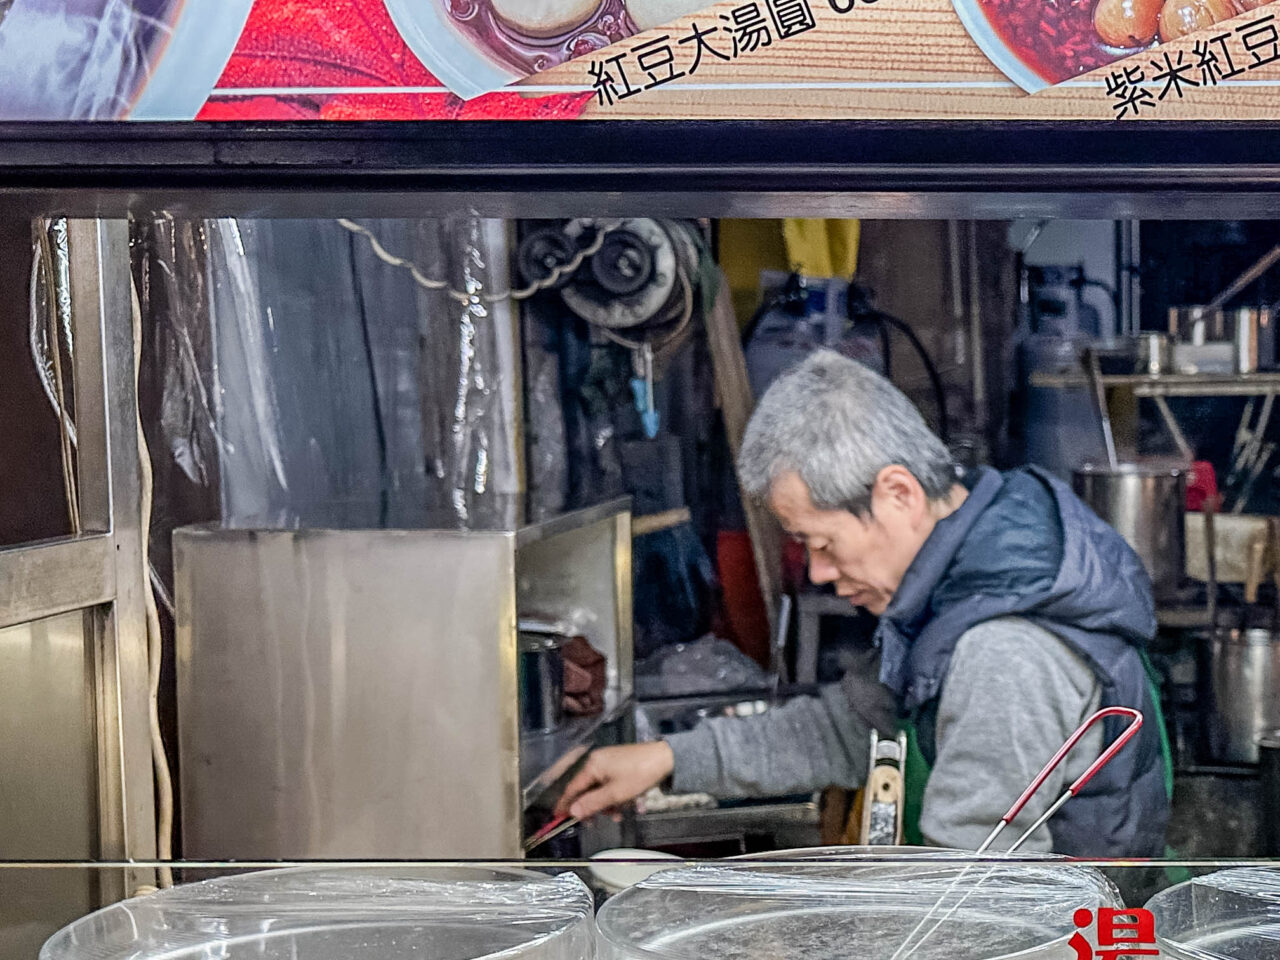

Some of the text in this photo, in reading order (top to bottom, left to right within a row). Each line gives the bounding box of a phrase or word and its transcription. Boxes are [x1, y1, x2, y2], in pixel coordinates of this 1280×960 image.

[588, 0, 816, 106] 紅豆大湯圓
